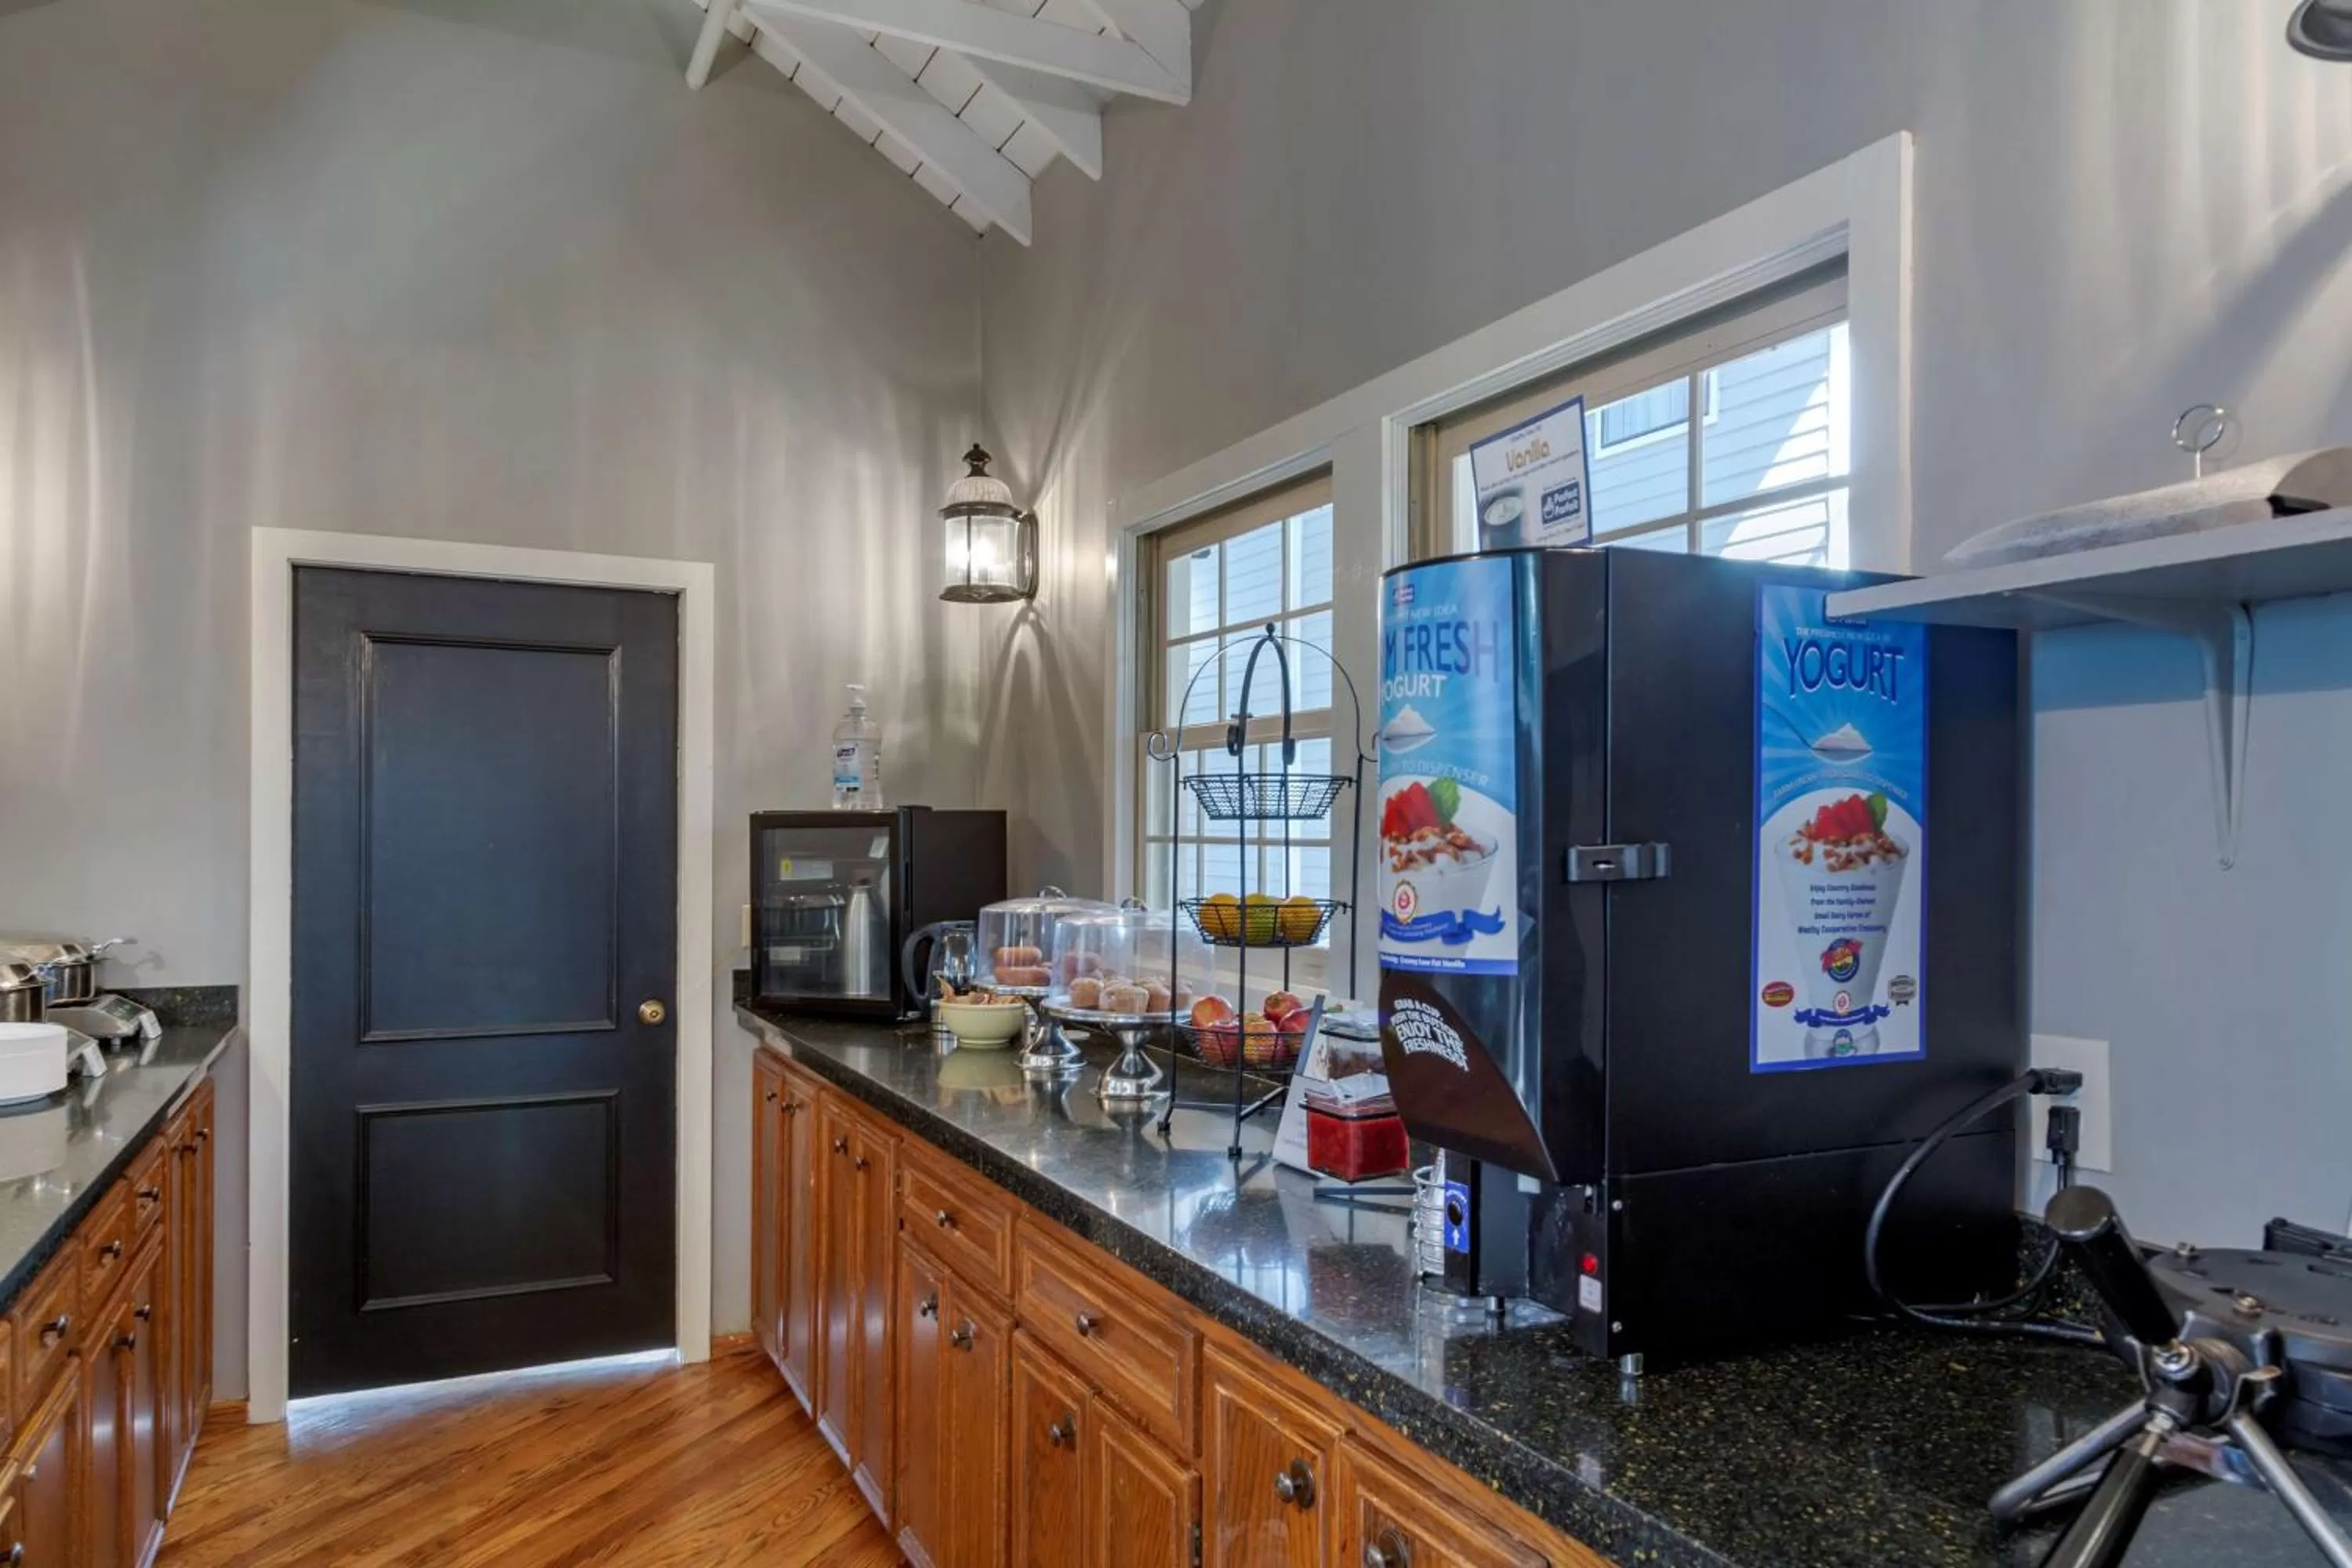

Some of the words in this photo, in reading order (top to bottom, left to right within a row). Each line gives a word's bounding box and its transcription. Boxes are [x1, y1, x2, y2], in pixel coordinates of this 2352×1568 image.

[1505, 437, 1550, 473] Vanilla
[1404, 619, 1499, 684] FRESH
[1783, 636, 1907, 706] YOGURT
[1417, 758, 1489, 787] DISPENSER
[1396, 1022, 1432, 1043] ENJOY
[1432, 1026, 1466, 1055] THE
